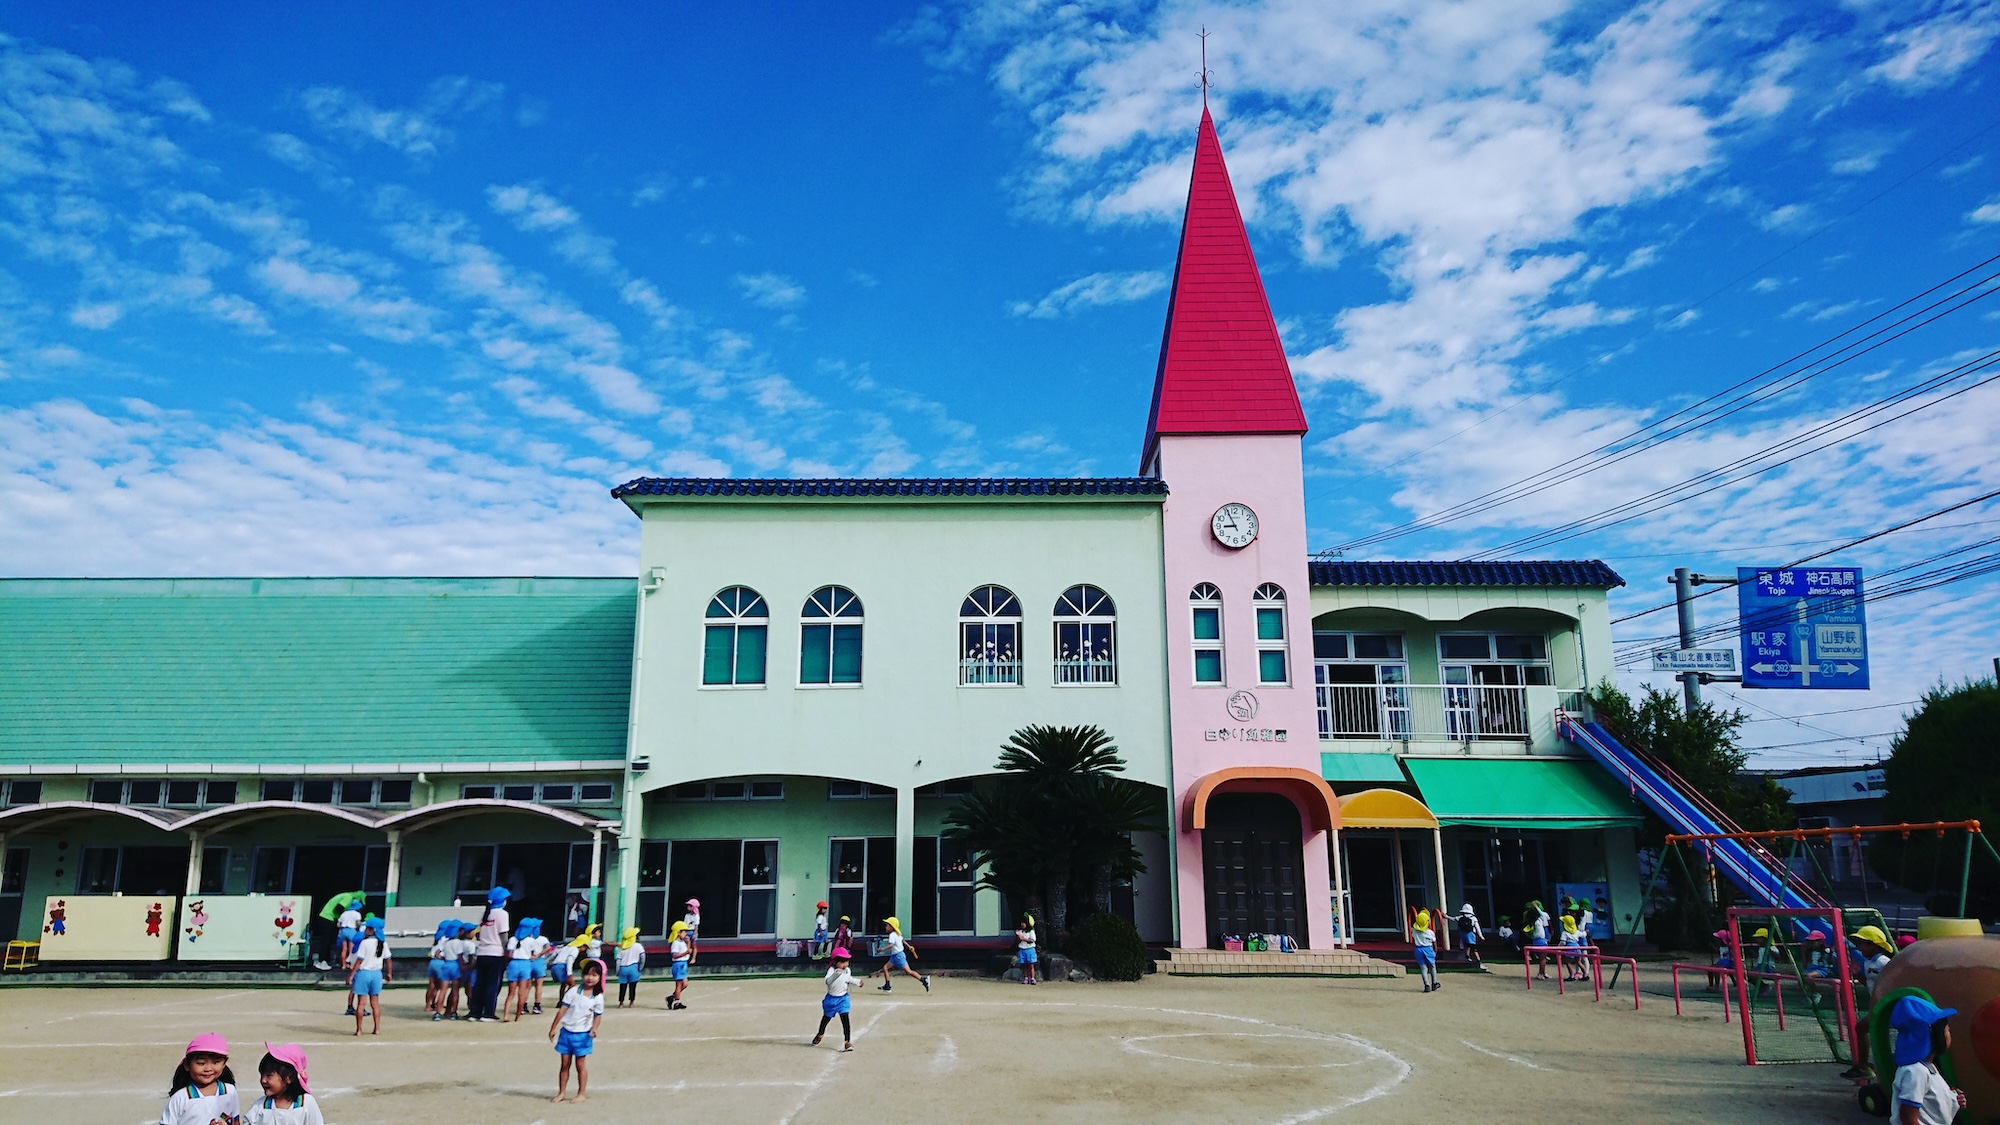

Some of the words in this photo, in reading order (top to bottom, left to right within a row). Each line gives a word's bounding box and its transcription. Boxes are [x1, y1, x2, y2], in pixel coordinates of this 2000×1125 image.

[1758, 571, 1794, 585] 東城
[1806, 571, 1855, 586] 神石高原
[1768, 586, 1786, 596] Tojo
[1822, 599, 1857, 614] 山野
[1751, 632, 1787, 646] 駅家
[1822, 630, 1857, 644] 山野峡
[1759, 647, 1781, 657] Ekiya
[1820, 646, 1861, 654] Yamanokyo
[1776, 664, 1789, 672] 392
[1823, 664, 1834, 674] 21
